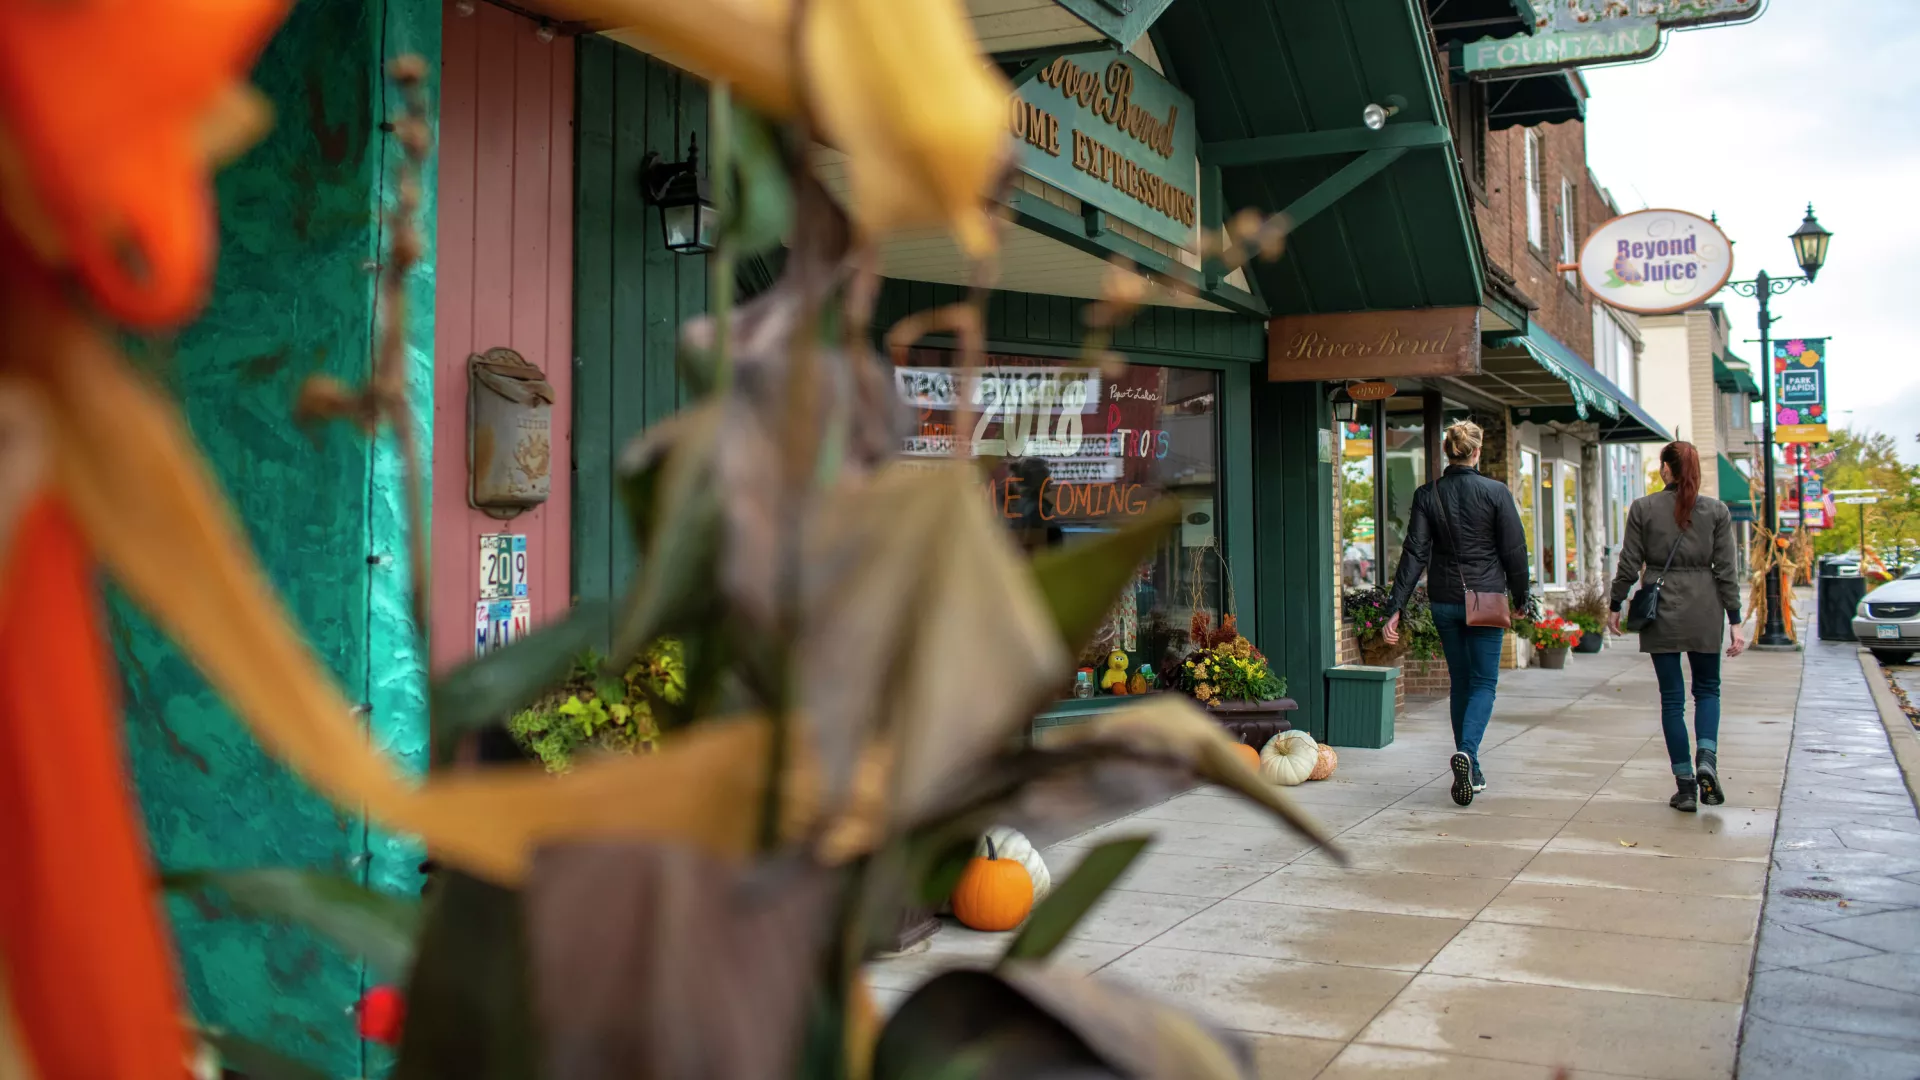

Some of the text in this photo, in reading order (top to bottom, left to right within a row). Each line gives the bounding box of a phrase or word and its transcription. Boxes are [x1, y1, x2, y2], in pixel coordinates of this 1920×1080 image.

[1477, 28, 1641, 69] FOUNTAIN
[1009, 95, 1196, 229] OME EXPRESSIONS
[1617, 234, 1697, 260] Beyond
[1642, 260, 1698, 282] Juice
[1355, 384, 1386, 400] open
[1785, 383, 1816, 392] RAPIDS
[1788, 376, 1812, 385] PARK
[971, 377, 1088, 457] 2018
[1038, 477, 1147, 521] COMING
